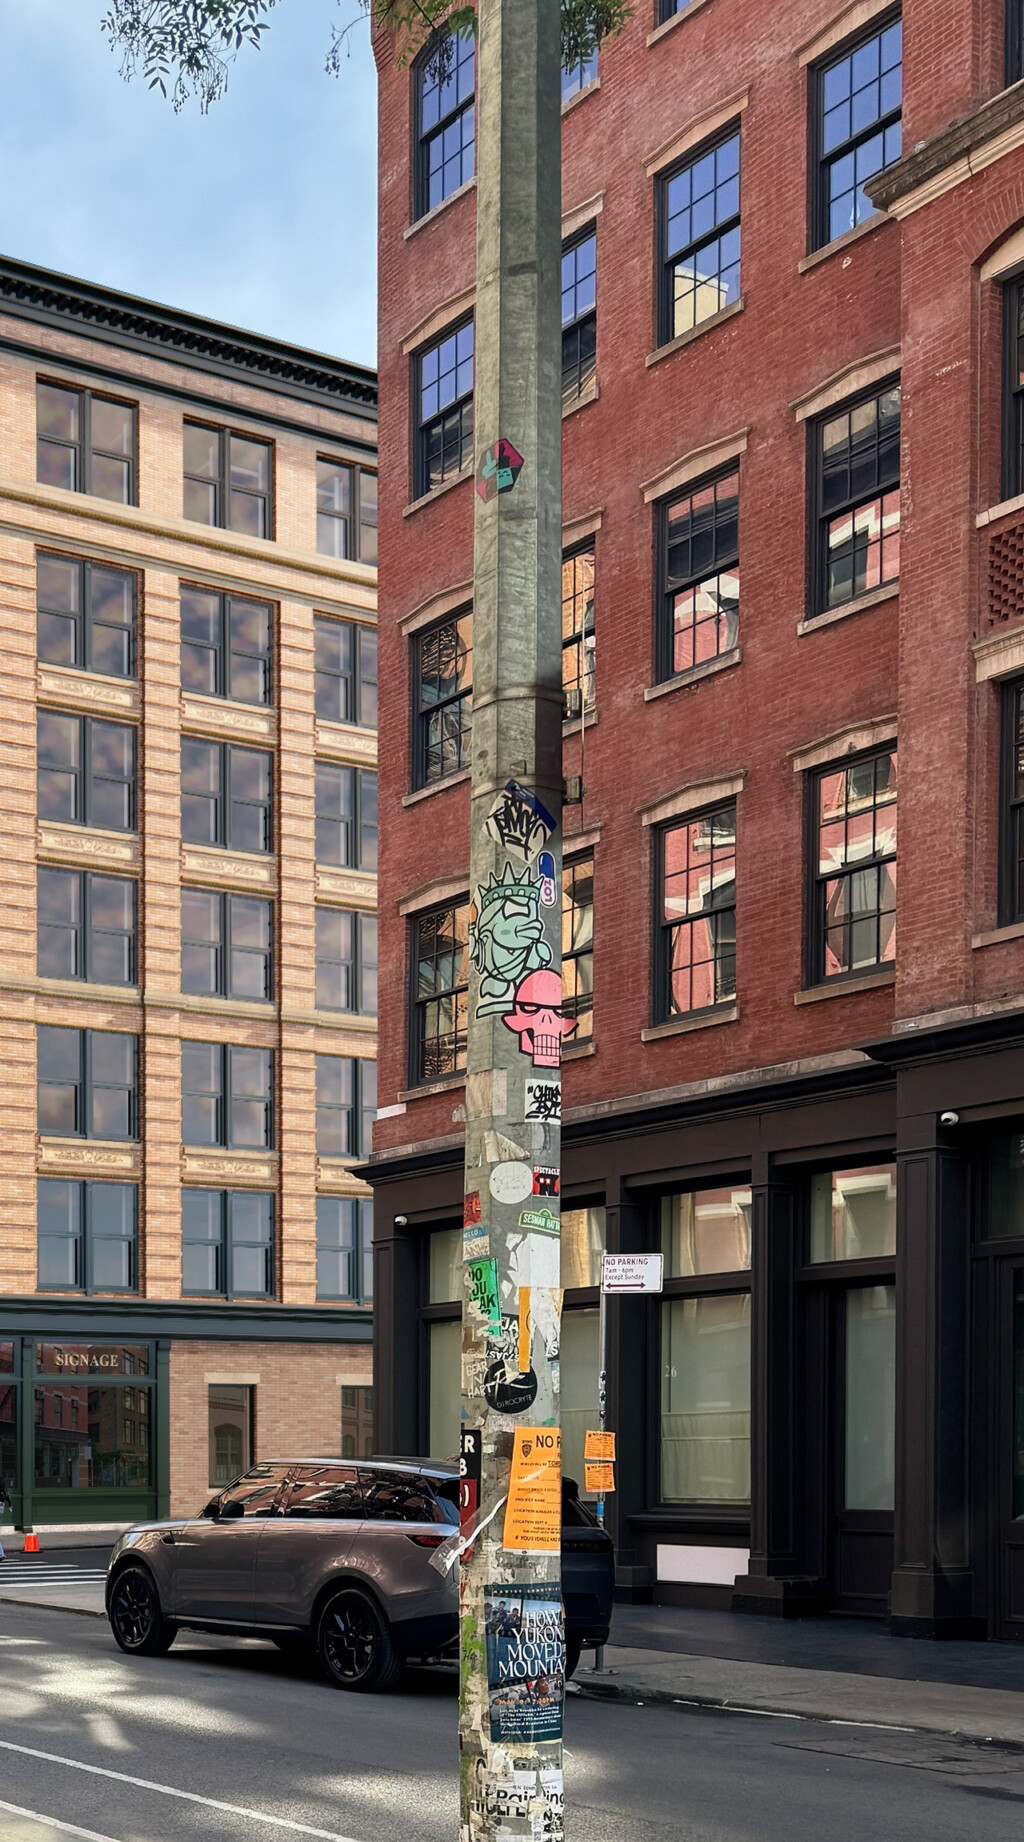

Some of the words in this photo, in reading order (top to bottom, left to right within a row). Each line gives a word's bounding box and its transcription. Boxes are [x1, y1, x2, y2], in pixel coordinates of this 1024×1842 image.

[617, 1258, 649, 1266] PARKING
[471, 1281, 487, 1297] OU
[56, 1353, 119, 1367] SIGNAGE
[665, 1365, 677, 1378] 26
[536, 1435, 554, 1448] NO
[526, 1610, 559, 1628] HOW
[511, 1625, 565, 1645] YUKON
[507, 1641, 563, 1661] MOVED
[498, 1658, 566, 1678] MOUNTA
